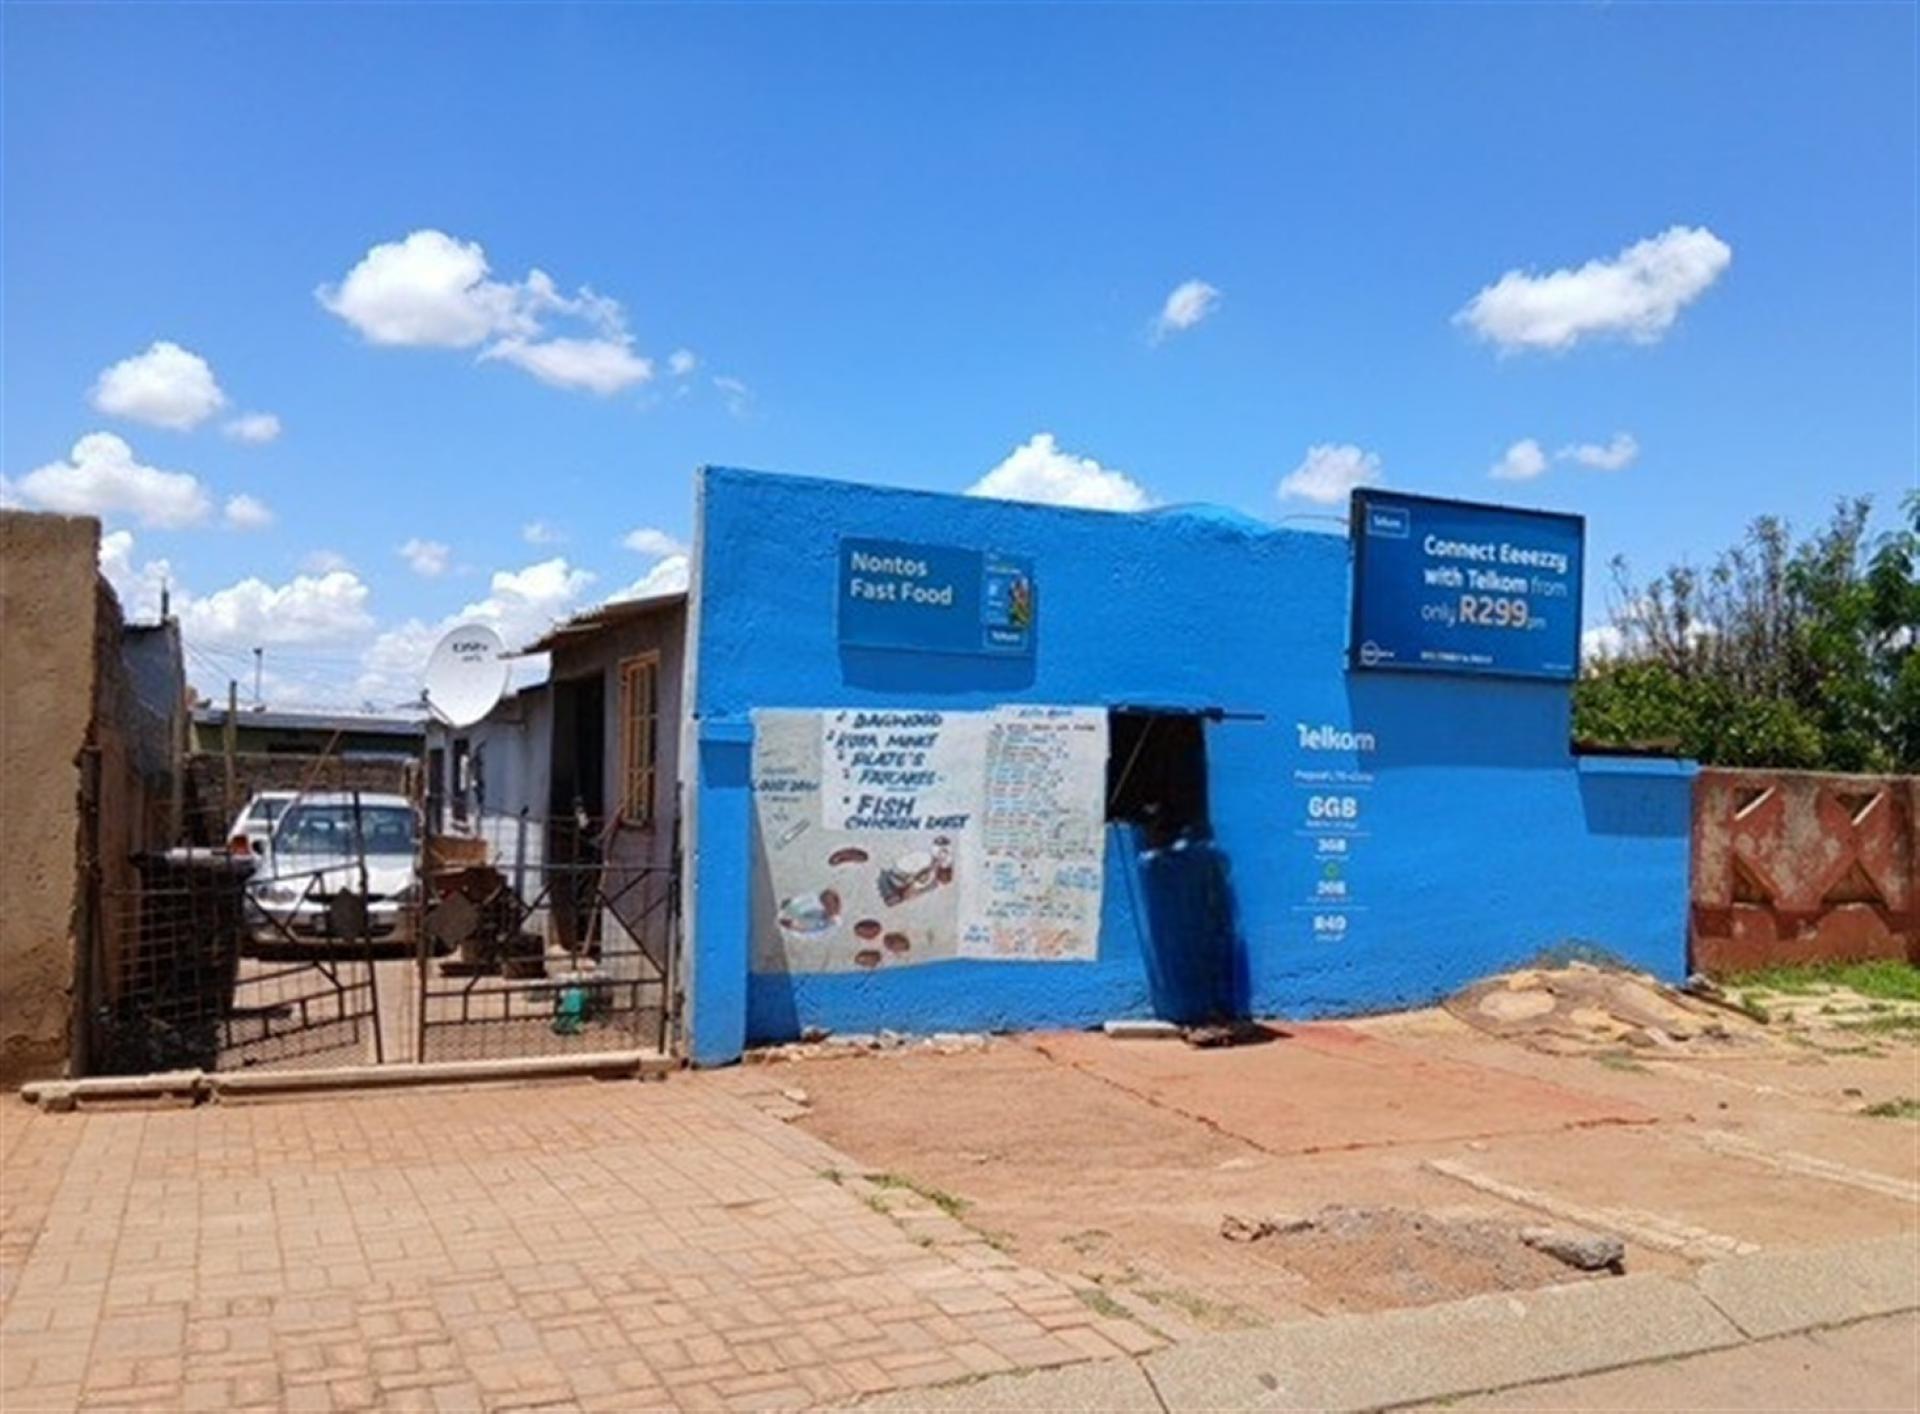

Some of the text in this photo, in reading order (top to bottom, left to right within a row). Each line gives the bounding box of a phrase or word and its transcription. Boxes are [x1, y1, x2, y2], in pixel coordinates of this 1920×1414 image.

[1424, 534, 1496, 562] Connect
[851, 551, 928, 577] Nontos
[850, 578, 953, 606] Fast Food
[1424, 566, 1568, 597] with Telkom from
[1421, 604, 1456, 627] only
[1460, 595, 1528, 628] R299
[1297, 723, 1376, 751] Telkom
[857, 795, 915, 816] FISH
